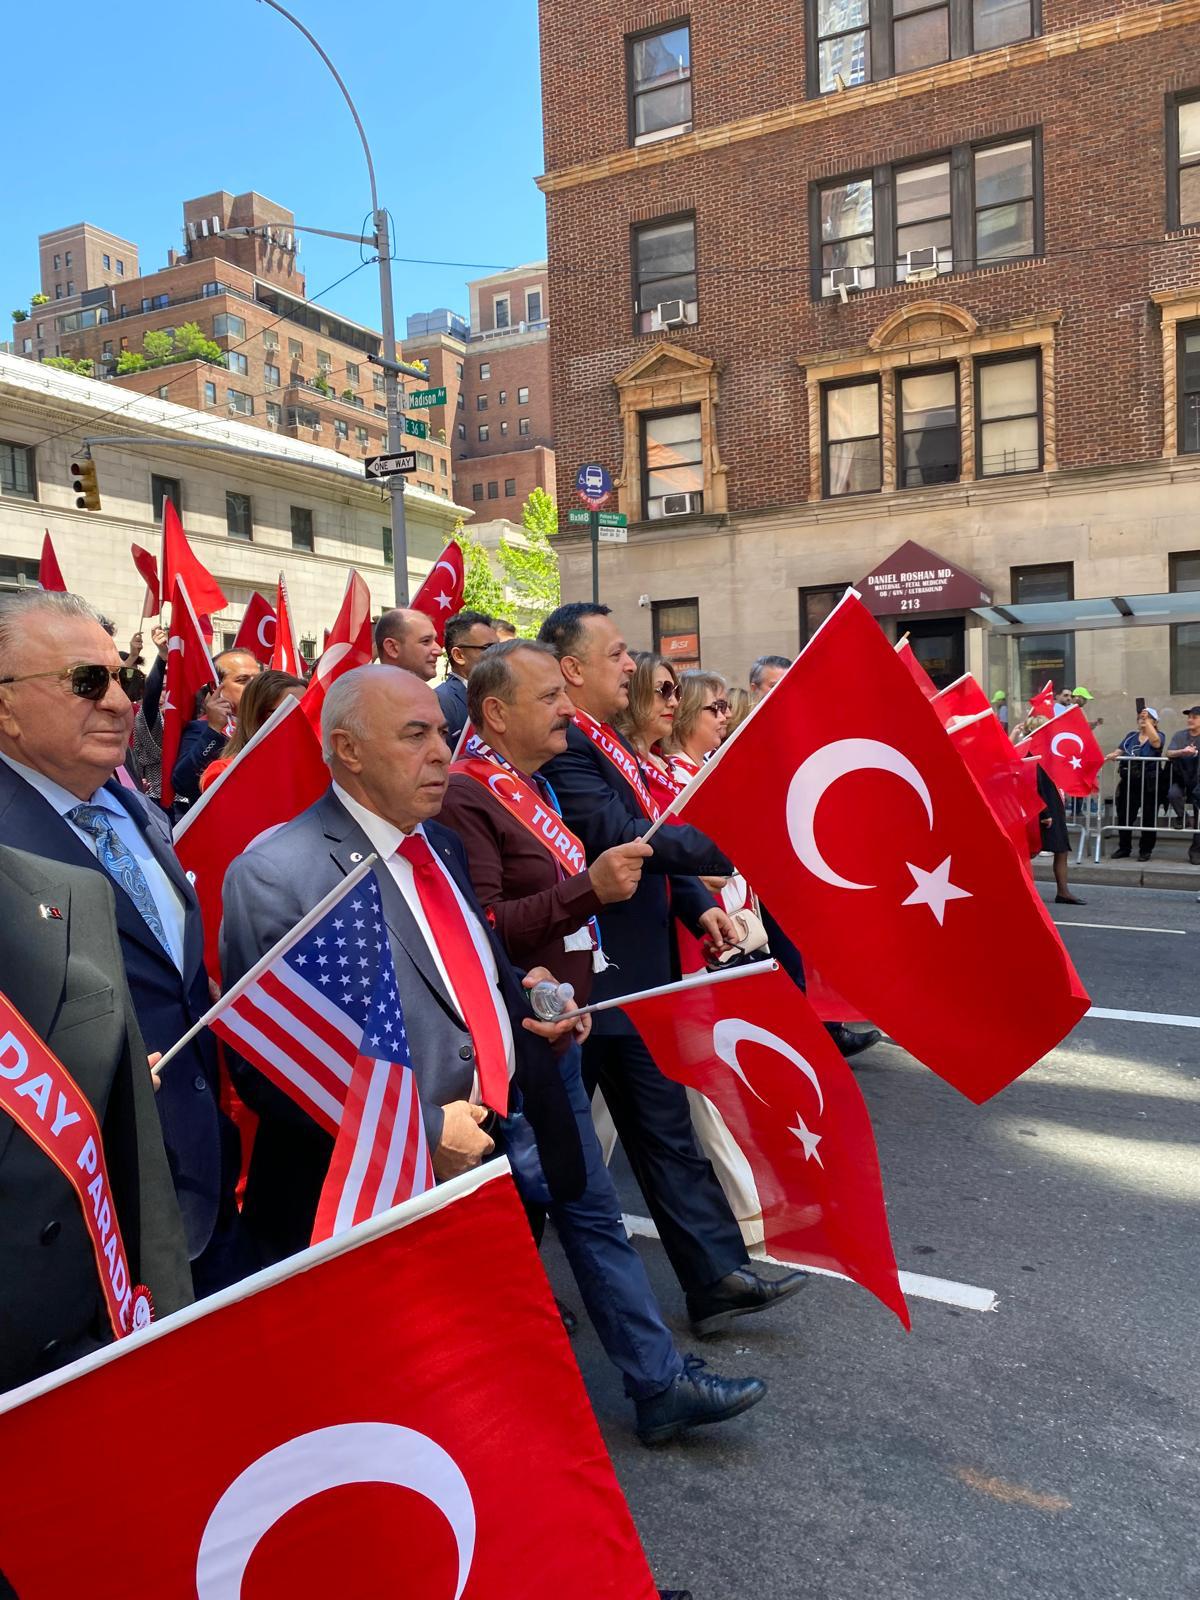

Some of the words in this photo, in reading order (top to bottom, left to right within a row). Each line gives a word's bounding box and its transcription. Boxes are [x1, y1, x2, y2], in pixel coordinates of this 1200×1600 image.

[410, 394, 437, 408] Madison
[406, 421, 410, 433] E
[411, 421, 419, 435] 36
[374, 461, 389, 471] ONE
[395, 458, 411, 468] WAY
[569, 513, 590, 522] BxM8
[868, 574, 897, 585] DANIEL
[900, 570, 935, 582] ROSHAN
[938, 568, 954, 578] MD.
[874, 583, 901, 591] MATERNAL
[908, 586, 943, 595] ULTRASOUND
[900, 598, 920, 610] 213
[590, 726, 651, 808] TURKISH
[637, 756, 681, 795] KISH
[0, 1030, 81, 1137] DAY
